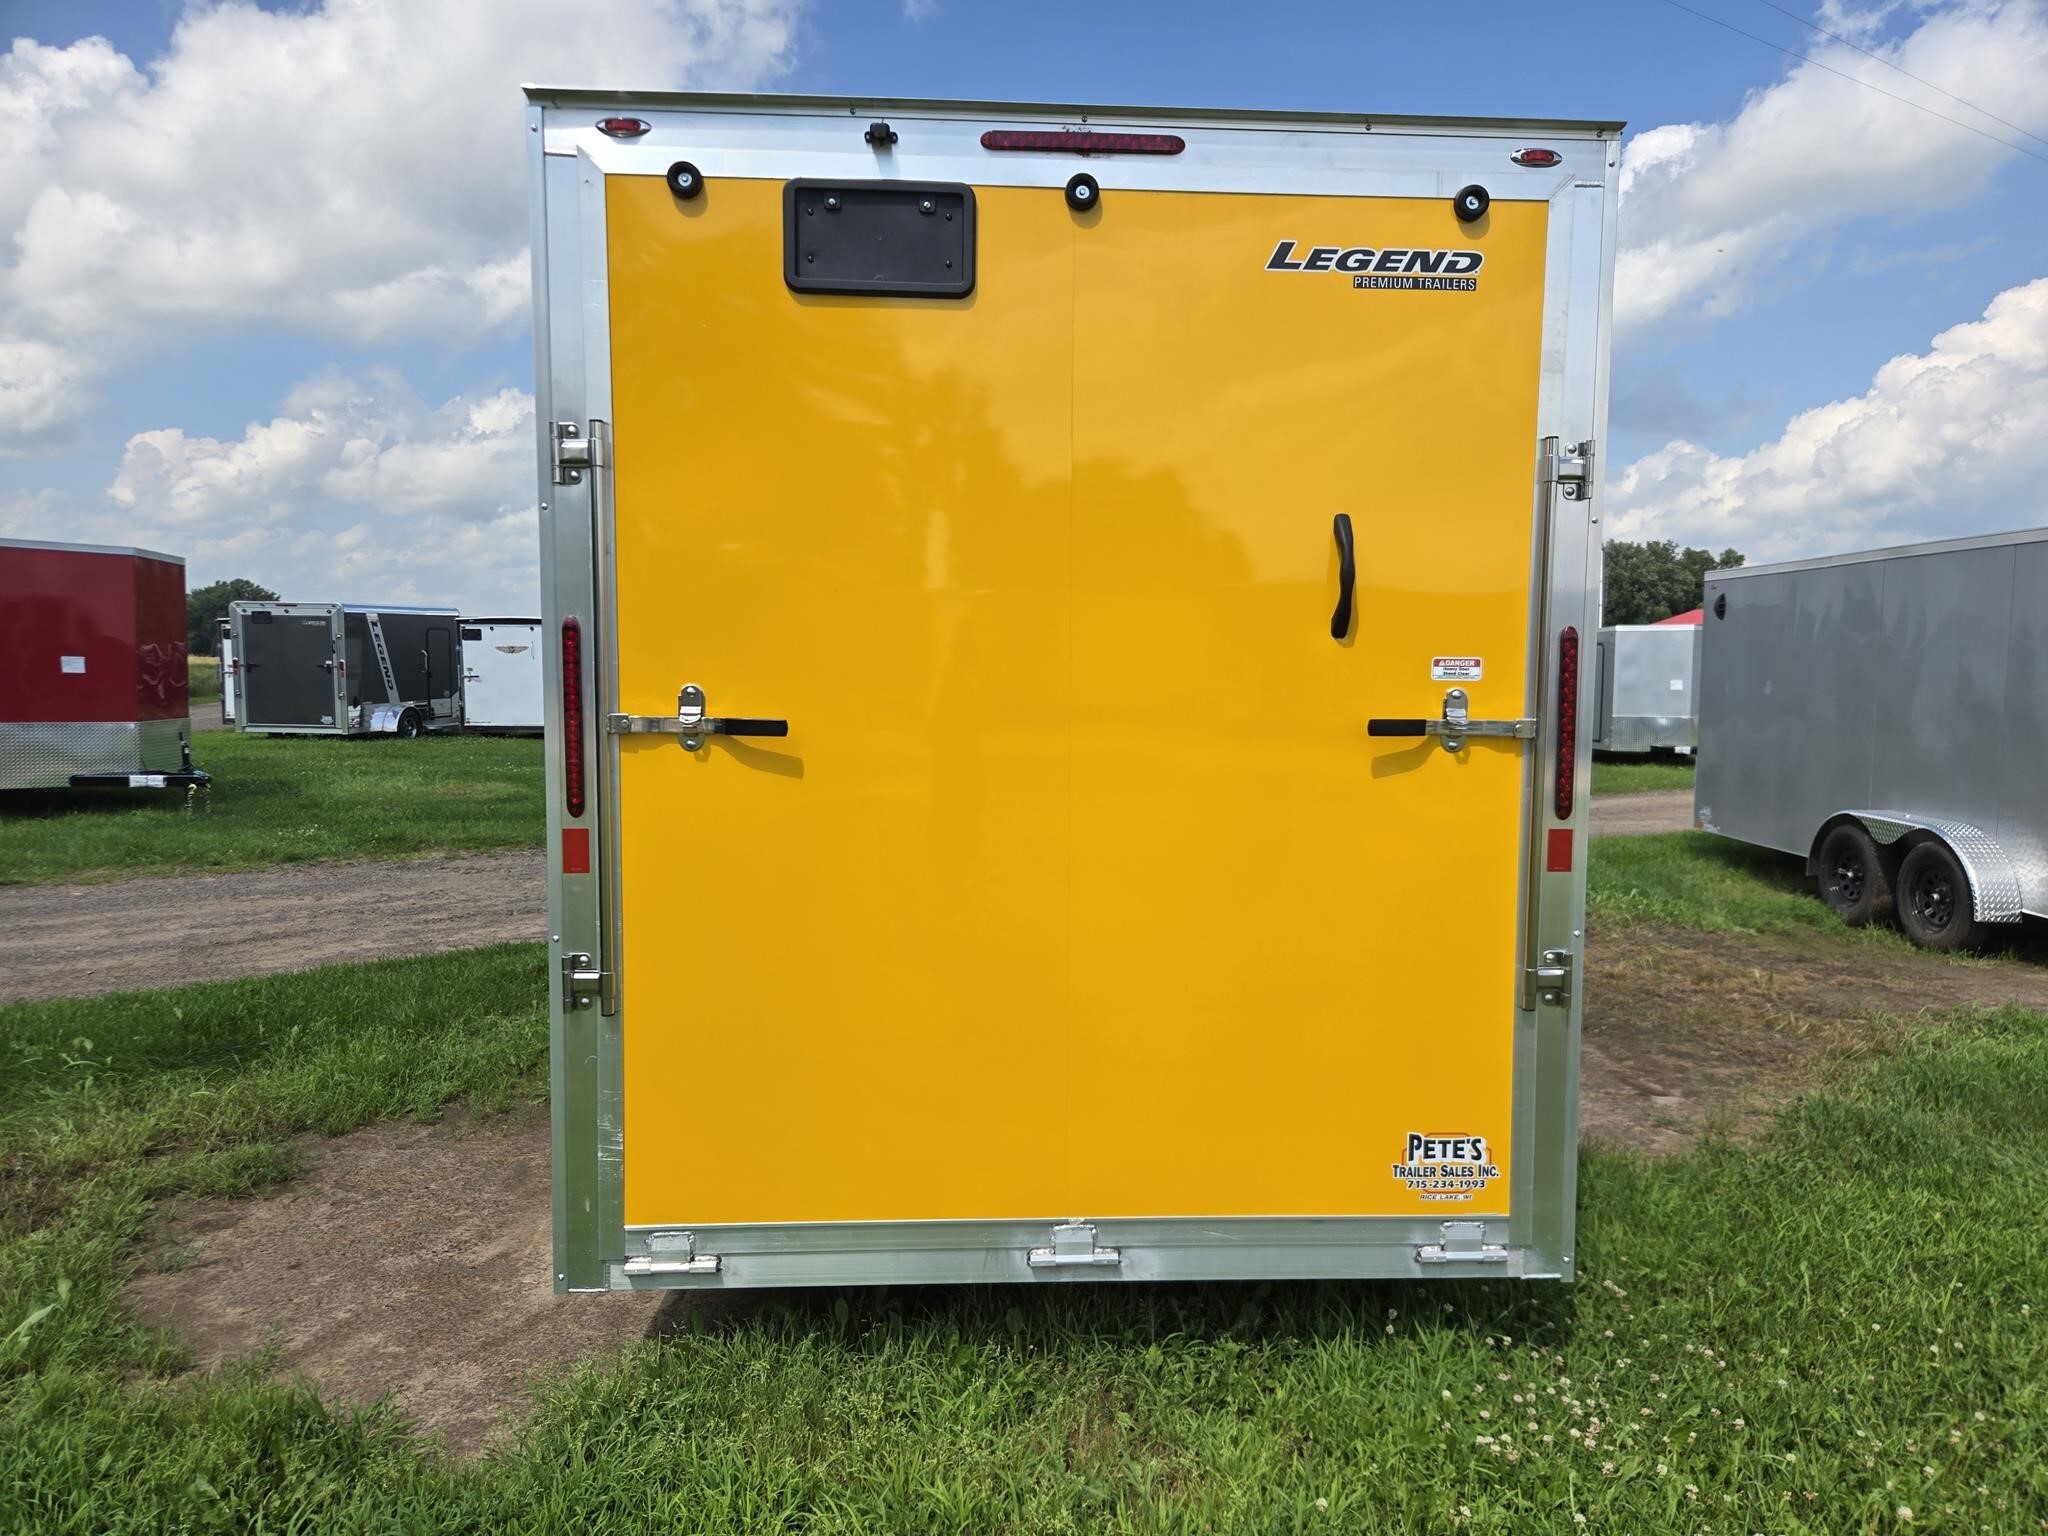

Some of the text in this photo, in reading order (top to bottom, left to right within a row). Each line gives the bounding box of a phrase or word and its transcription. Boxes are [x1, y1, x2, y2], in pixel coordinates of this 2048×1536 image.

[1266, 240, 1484, 274] LEGEND
[1354, 276, 1475, 291] PREMIUM TRAILERS
[370, 620, 394, 691] LEGEND
[1445, 659, 1475, 667] DANGER
[1408, 1133, 1483, 1162] PETE'S
[1392, 1164, 1499, 1178] TRAILER SALES INC.
[1407, 1180, 1485, 1189] 715-234-1993
